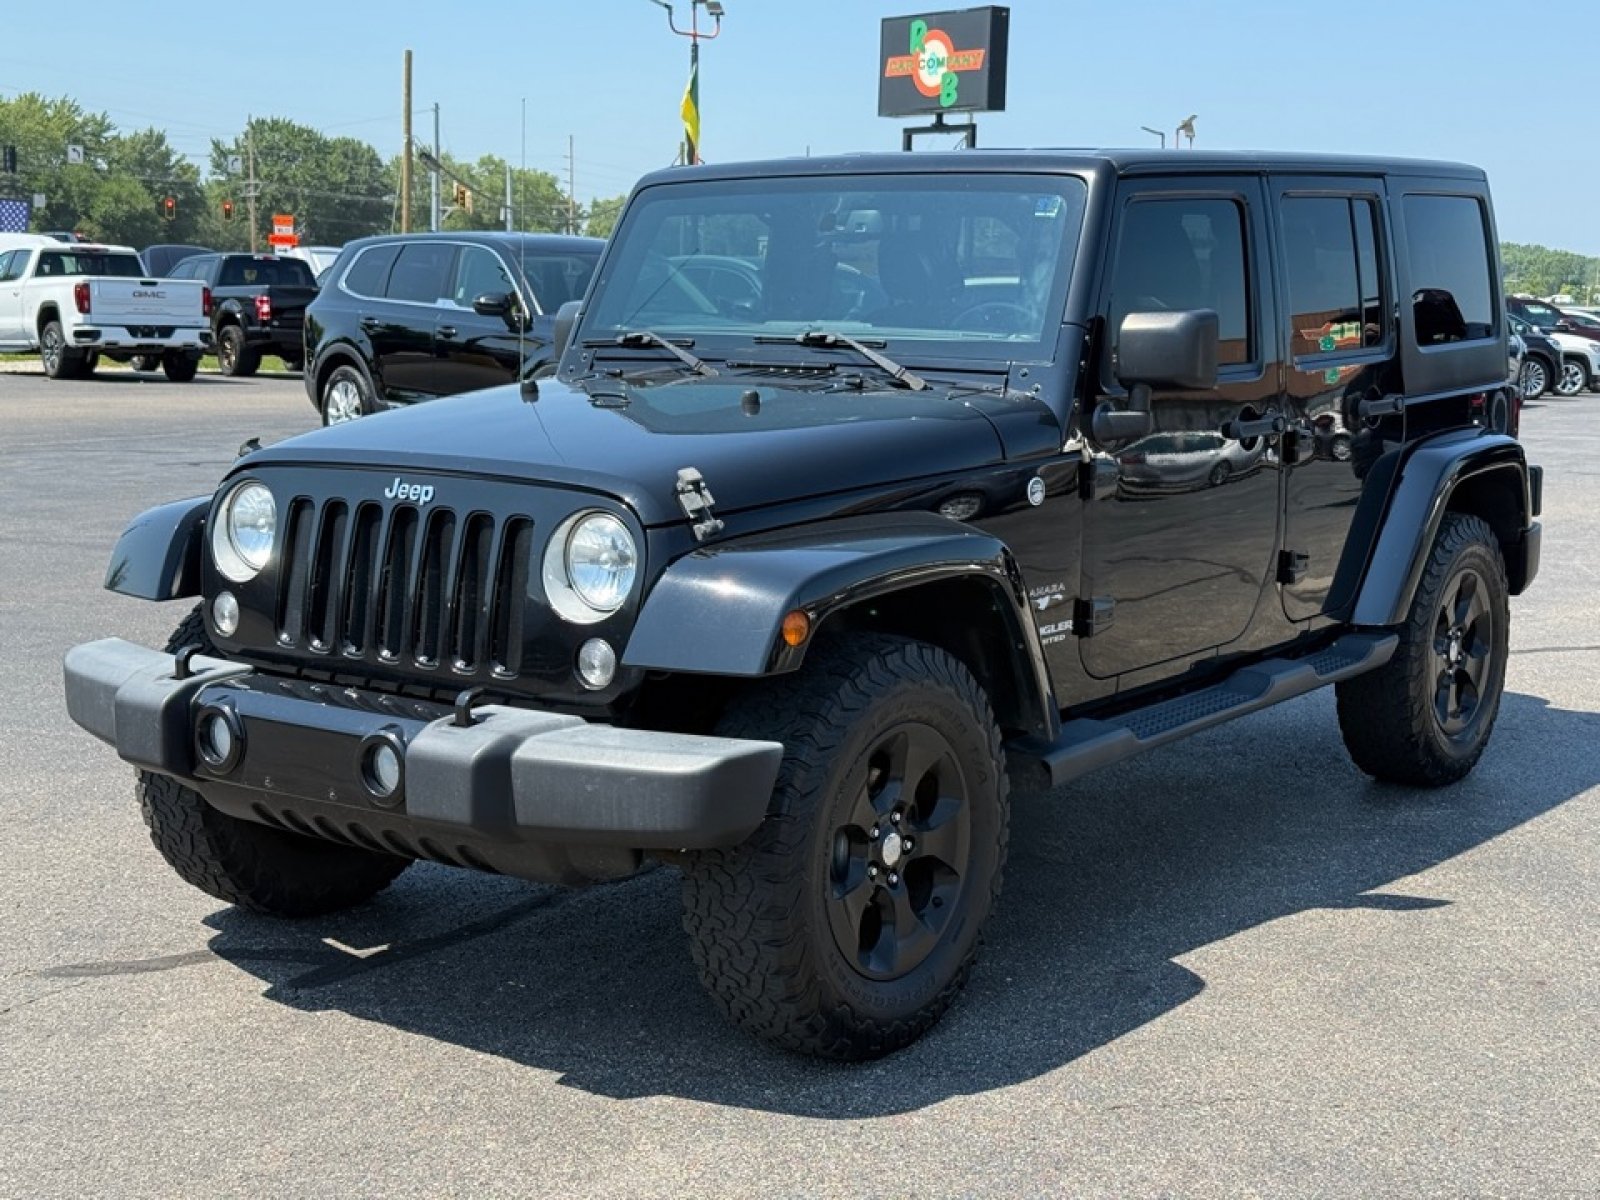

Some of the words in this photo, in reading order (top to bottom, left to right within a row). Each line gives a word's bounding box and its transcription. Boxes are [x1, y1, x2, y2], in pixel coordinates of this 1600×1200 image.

[918, 53, 980, 71] COMPANY
[940, 71, 958, 107] B
[133, 291, 167, 299] GMC
[384, 477, 434, 505] Jeep
